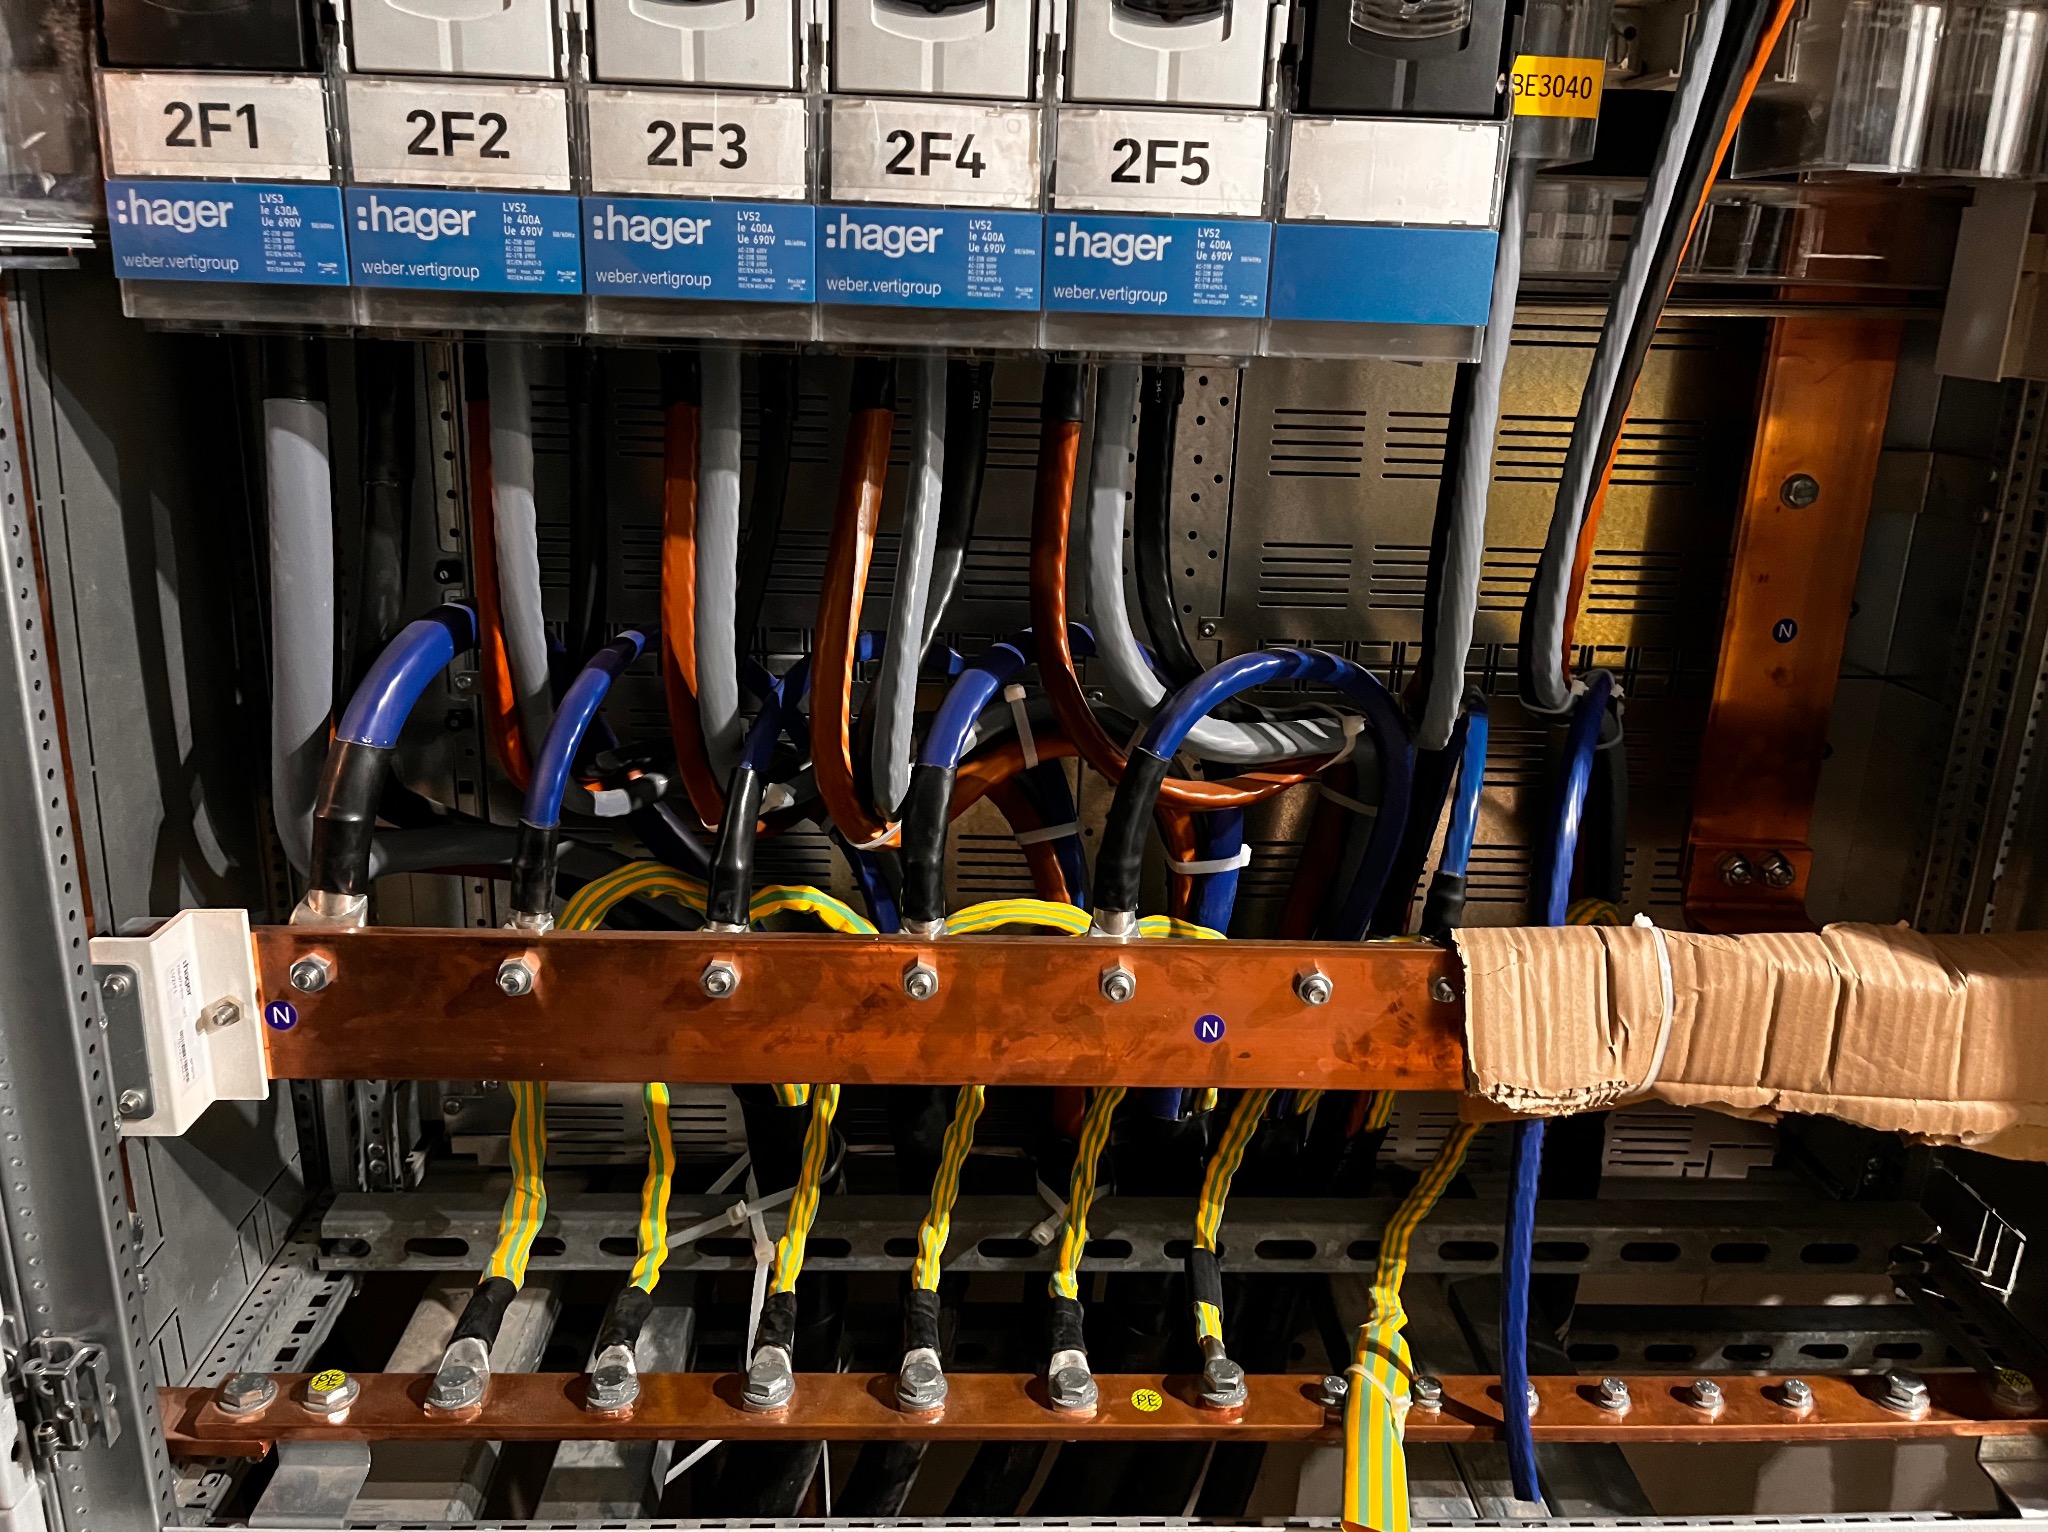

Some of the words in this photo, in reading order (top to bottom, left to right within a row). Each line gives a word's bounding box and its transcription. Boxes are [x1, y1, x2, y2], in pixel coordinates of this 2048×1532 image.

[163, 101, 259, 149] 2F1
[405, 109, 510, 159] 2F2
[646, 120, 748, 169] 2F3
[885, 129, 986, 178] 2F4
[1110, 138, 1210, 186] 2F5
[259, 193, 284, 204] LVS3
[274, 206, 299, 216] 630A
[503, 202, 527, 212] LVS2
[517, 215, 541, 224] 400A
[737, 211, 760, 221] LVS2
[262, 217, 274, 226] Ue
[278, 217, 301, 228] 690V
[751, 224, 773, 233] 400A
[970, 220, 992, 230] LVS2
[504, 226, 516, 235] Ue
[520, 226, 543, 236] 690V
[1198, 228, 1220, 238] LVS2
[738, 235, 749, 243] Ue
[753, 235, 775, 245] 690V
[982, 233, 1004, 242] 400A
[969, 243, 980, 252] Ue
[984, 244, 1006, 253] 690V
[1210, 240, 1231, 250] 400A
[1196, 250, 1207, 260] Ue
[1211, 252, 1233, 261] 690V
[122, 252, 239, 274] weber.vertigroup
[361, 260, 480, 282] weber.vertigroup
[595, 268, 712, 290] weber.vertigroup
[826, 276, 942, 297] weber.vertigroup
[1053, 285, 1168, 305] weber.vertigroup
[1778, 623, 1793, 638] N
[272, 1006, 290, 1024] N
[1202, 1021, 1218, 1038] N
[315, 1373, 340, 1387] PE
[1136, 1394, 1159, 1407] PE
